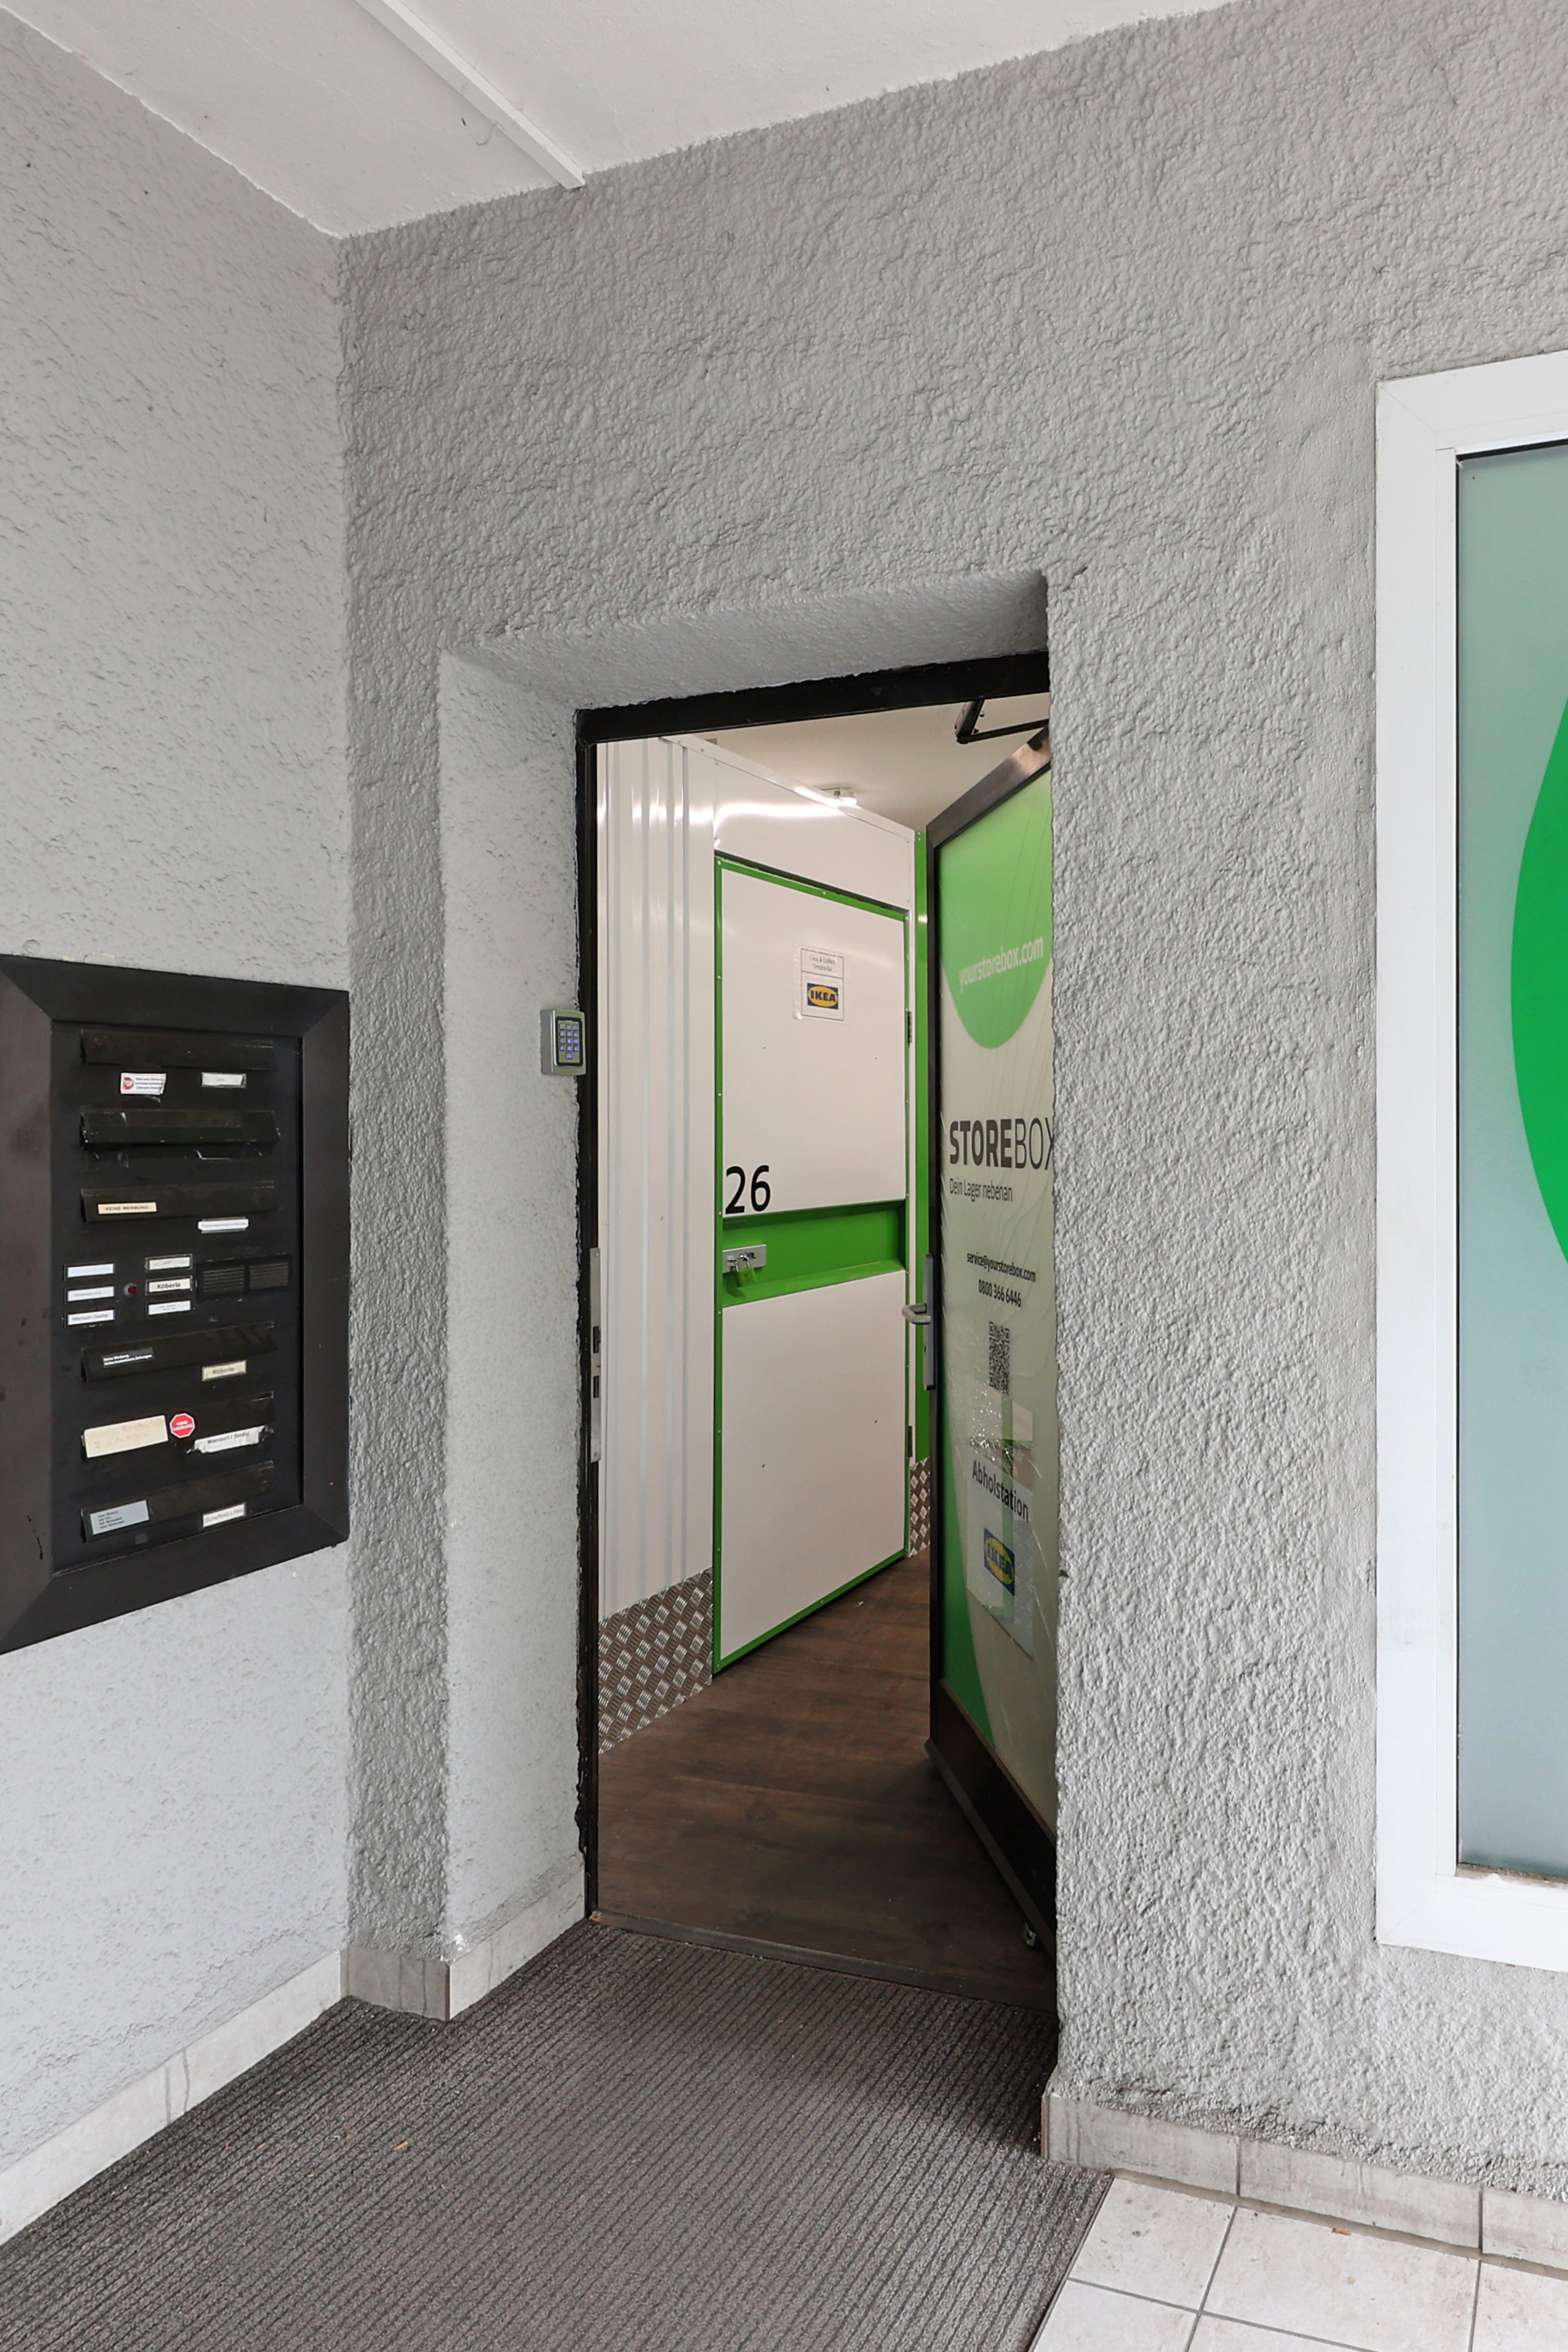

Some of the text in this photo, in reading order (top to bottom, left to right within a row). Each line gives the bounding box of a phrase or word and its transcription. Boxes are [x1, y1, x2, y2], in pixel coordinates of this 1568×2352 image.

[959, 937, 1043, 994] yourstorebox.com
[811, 990, 836, 1002] IKEA
[725, 1165, 770, 1214] 26
[950, 1177, 1012, 1202] Dein Lager nebenan
[967, 1252, 1036, 1282] service@yourstorebox.com
[979, 1279, 1022, 1308] 0800 366 6446
[972, 1460, 1029, 1523] Abholstation
[987, 1543, 1013, 1581] IKEA
